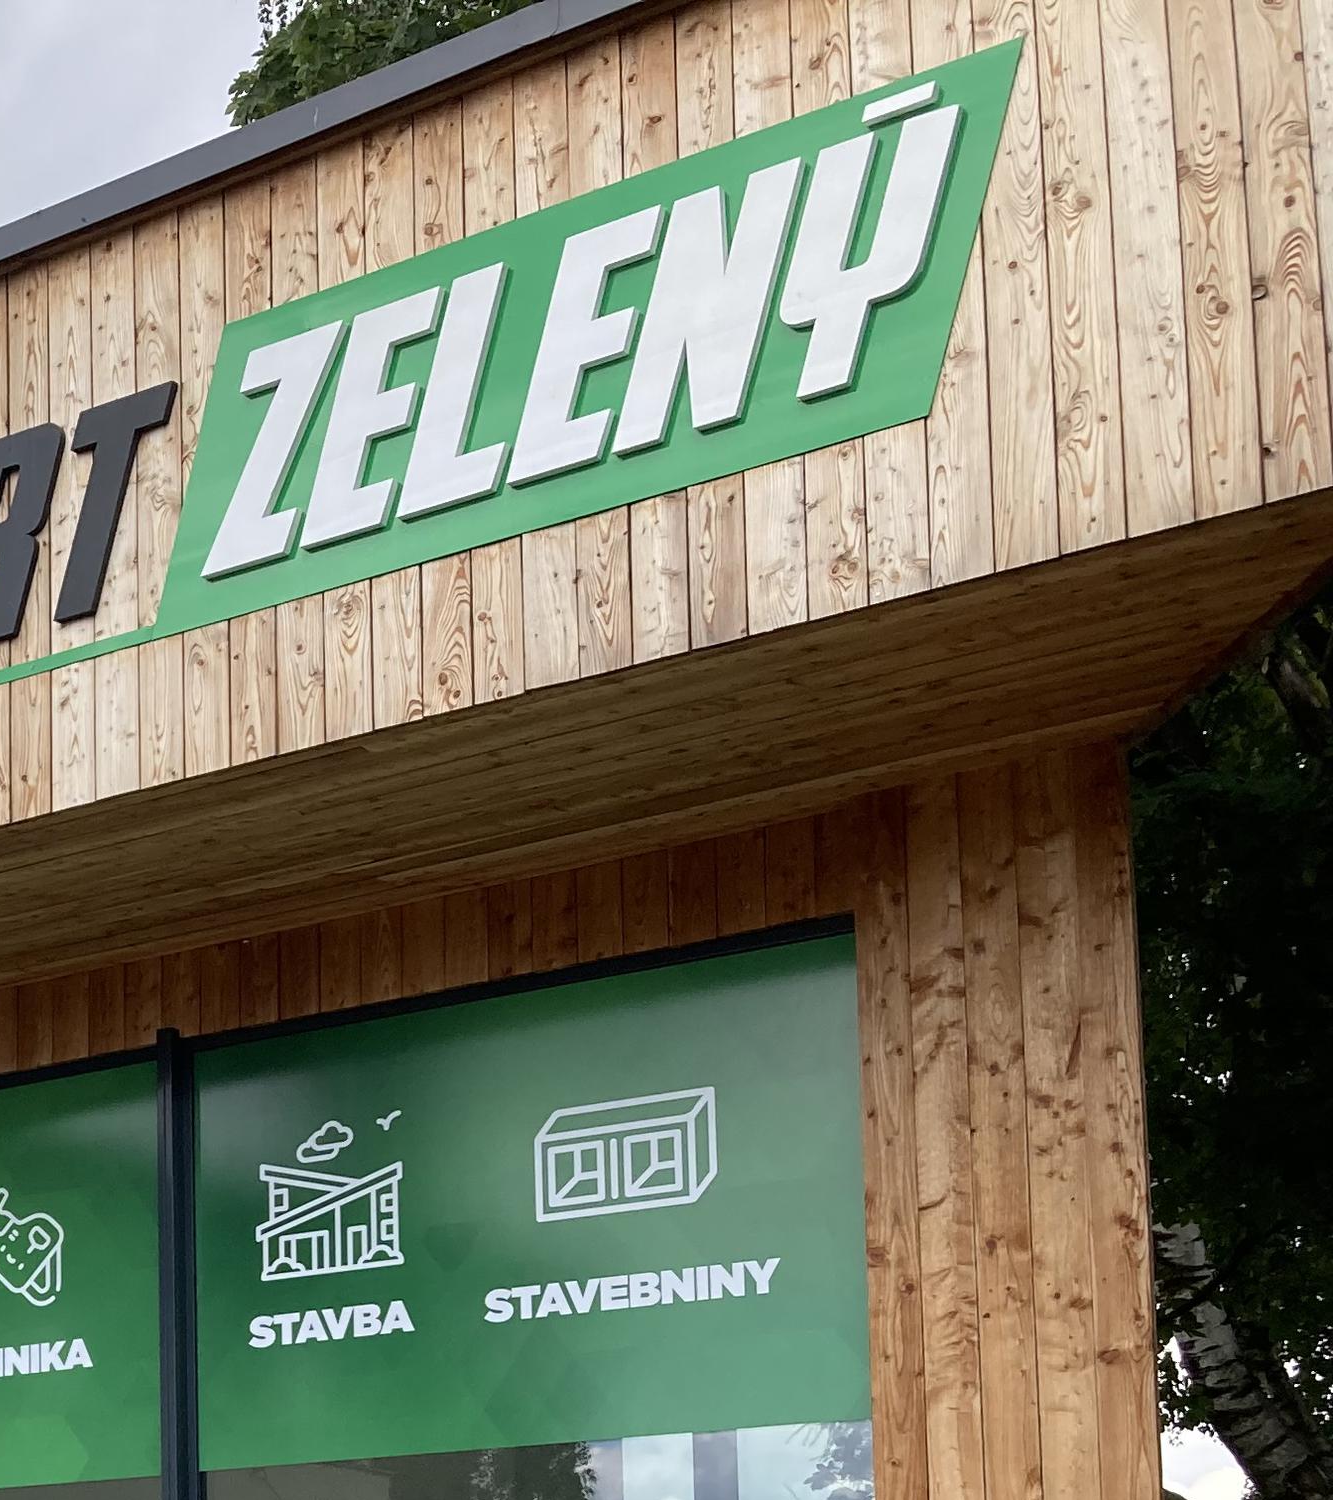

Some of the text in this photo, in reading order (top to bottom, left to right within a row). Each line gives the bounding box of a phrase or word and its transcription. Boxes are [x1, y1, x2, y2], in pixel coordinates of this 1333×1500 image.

[201, 80, 966, 582] ZELENÝ
[484, 1257, 781, 1323] STAVEBNINY
[247, 1300, 415, 1348] STAVBA
